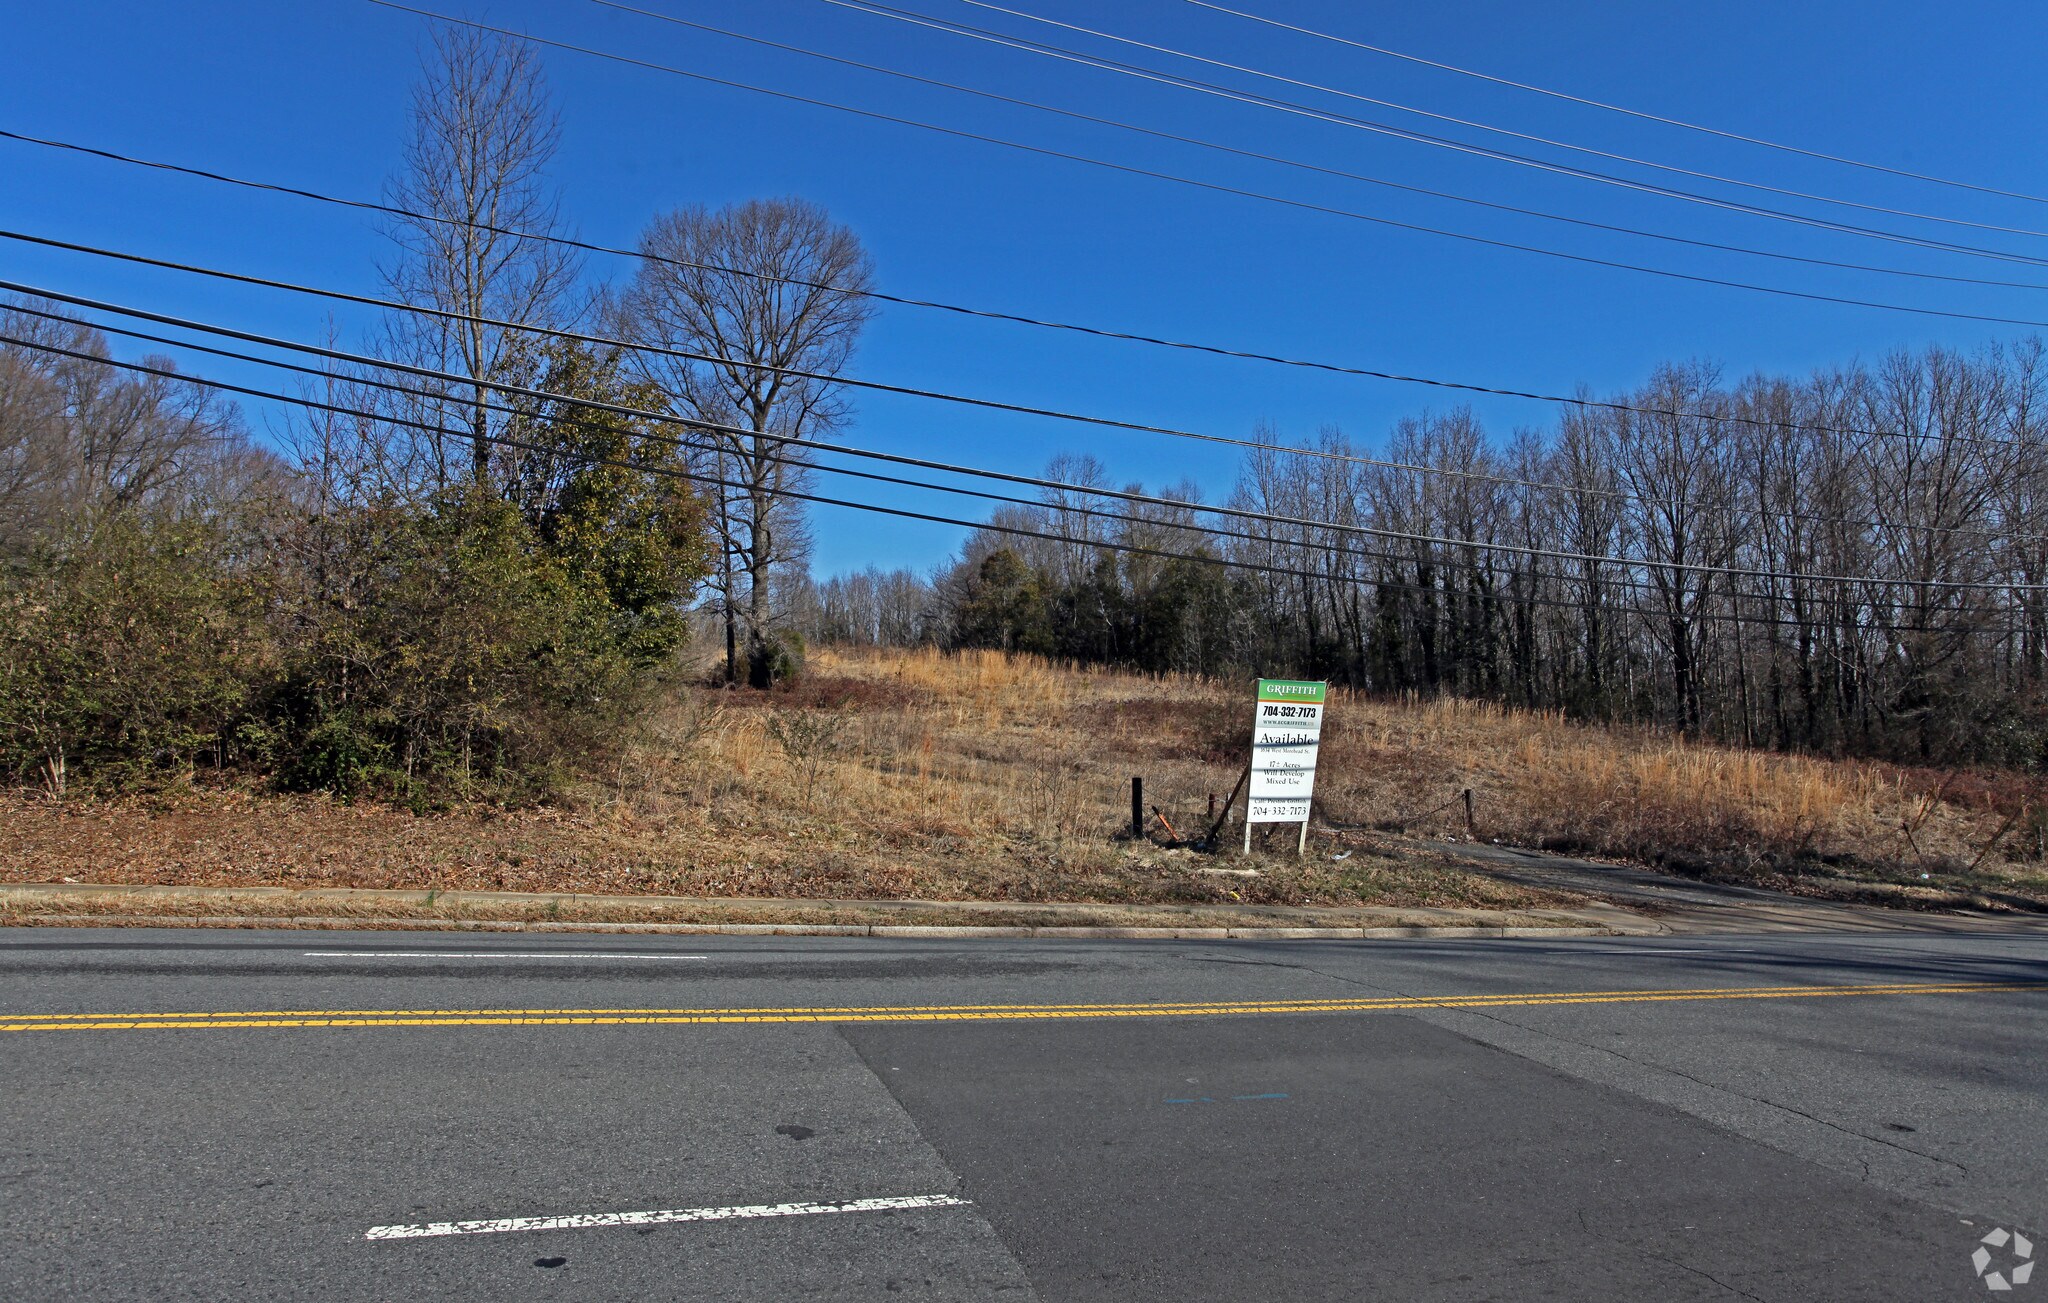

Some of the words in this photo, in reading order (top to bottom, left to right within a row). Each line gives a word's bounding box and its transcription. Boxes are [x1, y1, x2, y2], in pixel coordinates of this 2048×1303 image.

[1267, 684, 1317, 696] GRIFFITH
[1262, 705, 1316, 718] 704-332-7173
[1260, 733, 1314, 745] Available
[1279, 769, 1305, 777] Develop
[1253, 806, 1307, 816] 704-332-7173
